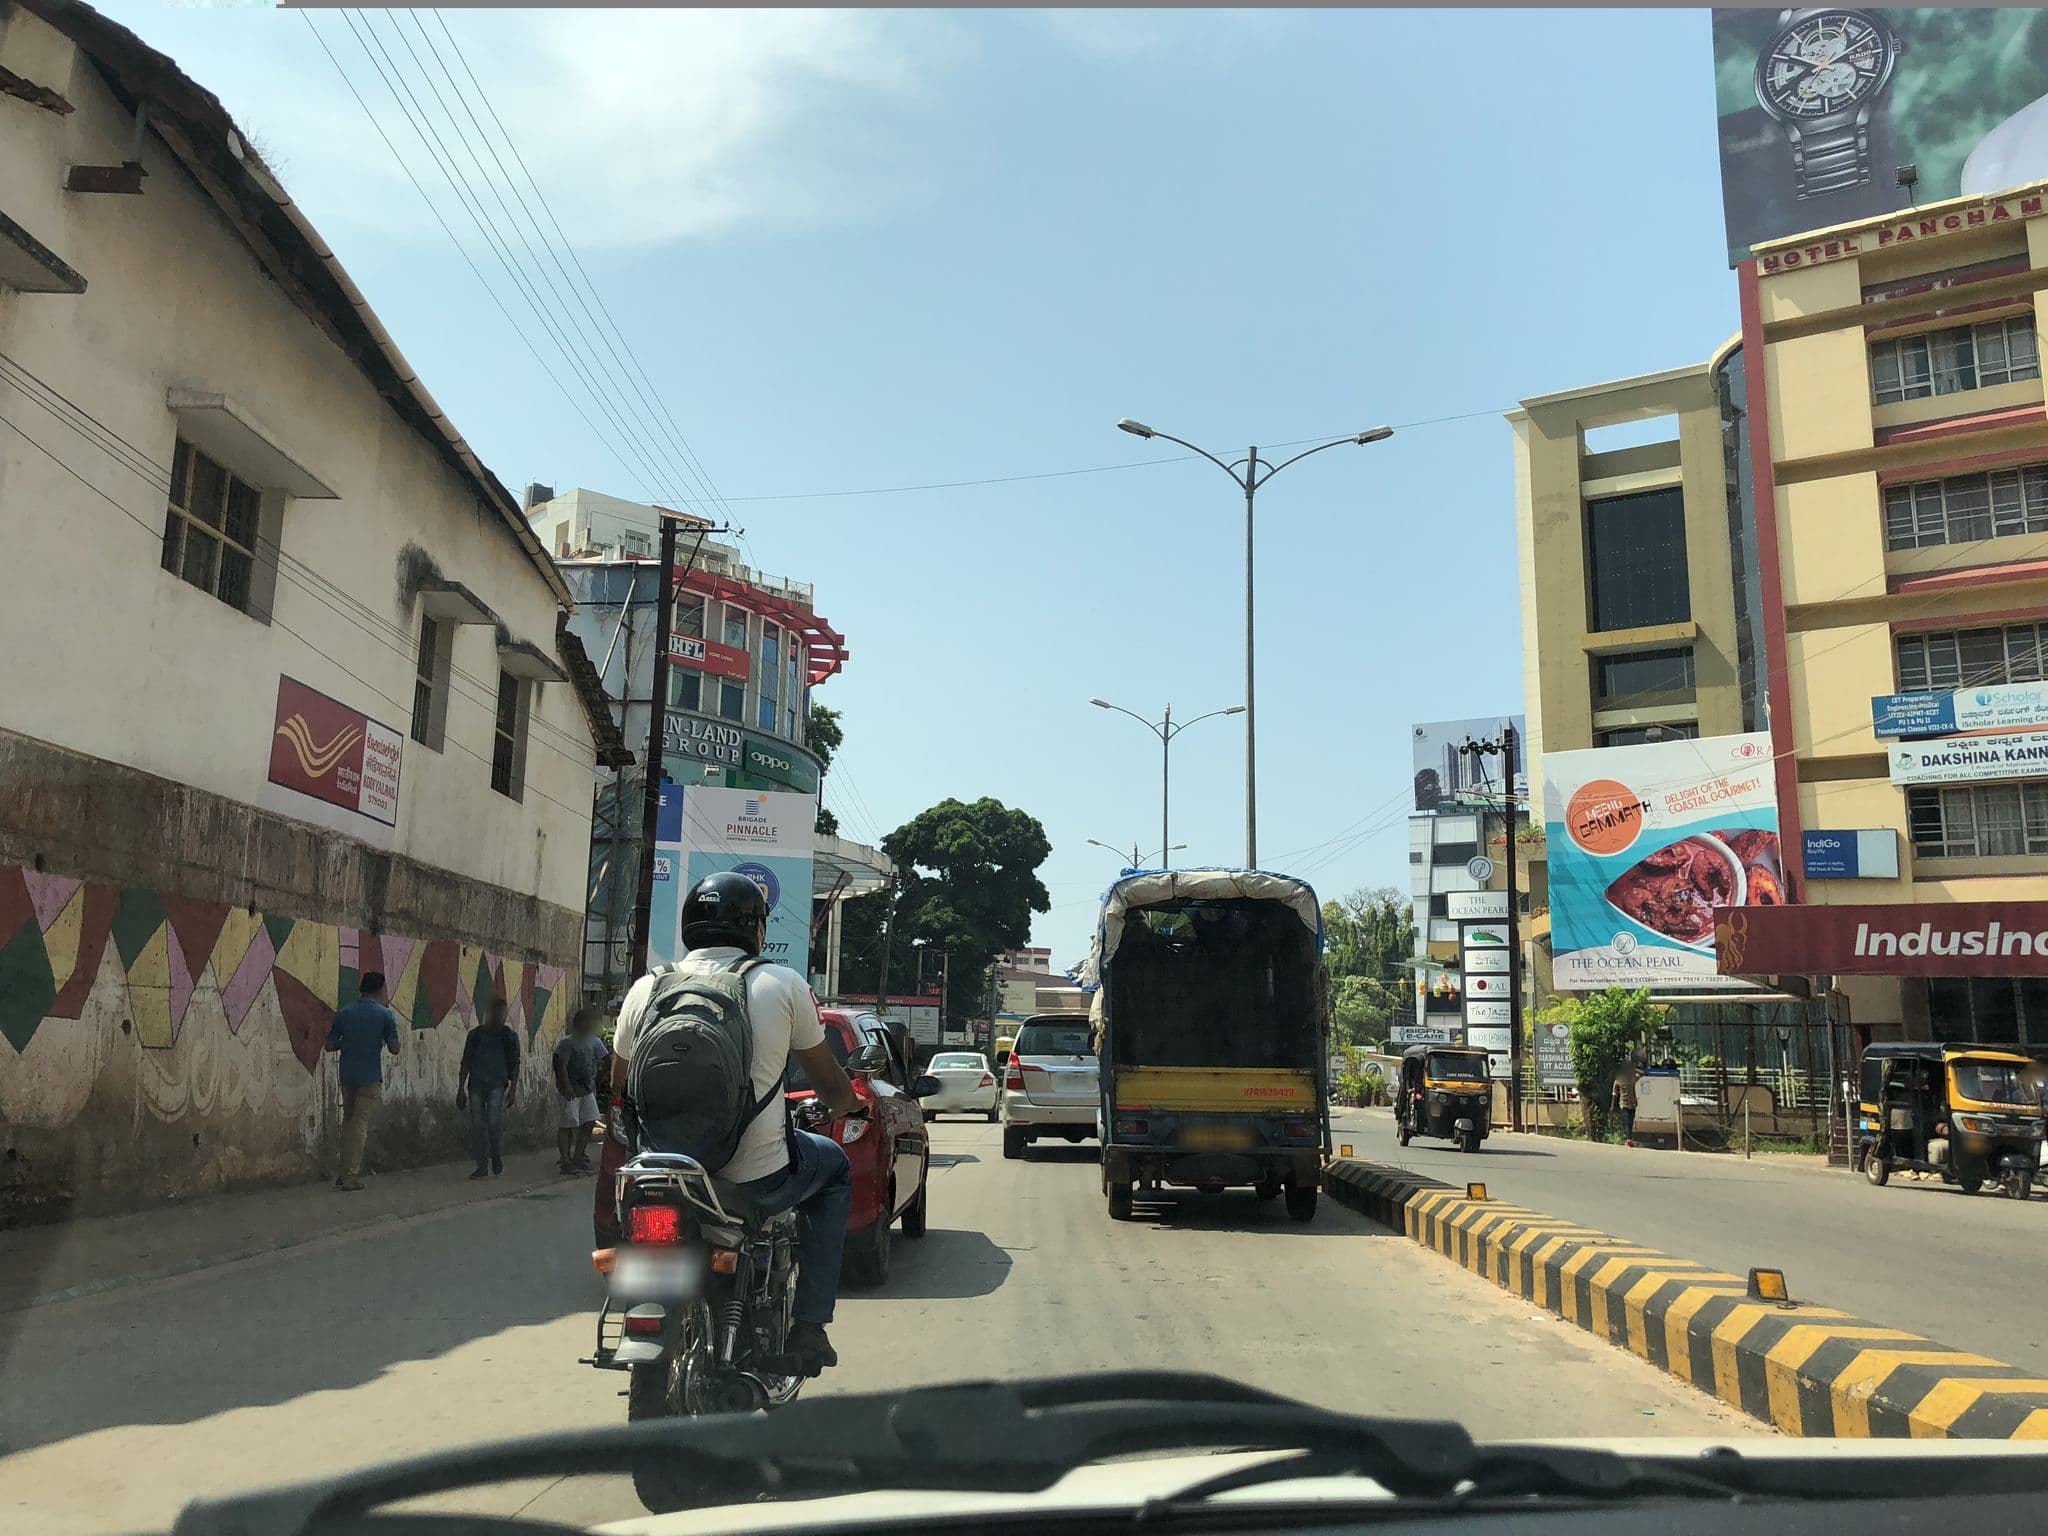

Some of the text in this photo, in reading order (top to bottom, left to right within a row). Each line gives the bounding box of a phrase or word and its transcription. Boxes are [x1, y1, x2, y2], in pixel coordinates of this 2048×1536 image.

[1850, 51, 1872, 62] RADO
[1763, 197, 2042, 272] HOTEL PANCHAM
[669, 635, 703, 659] HFL
[1996, 716, 2033, 726] Learning
[663, 715, 741, 747] IN-LAND
[662, 735, 739, 762] GROUP
[1921, 750, 2000, 767] DAKSHINA
[1906, 773, 1942, 782] COACHING
[1974, 769, 2019, 777] COMPETITIVE
[1664, 777, 1730, 804] DELIGHT OF THE
[1668, 777, 1762, 815] COASTAL GOURMET!
[726, 824, 778, 836] PINNACLE
[1807, 839, 1840, 848] IndiGo
[1468, 896, 1488, 905] THE
[1452, 906, 1481, 915] OCEAN
[762, 942, 789, 953] 9977
[1569, 956, 1684, 969] THE OCEAN PEARL
